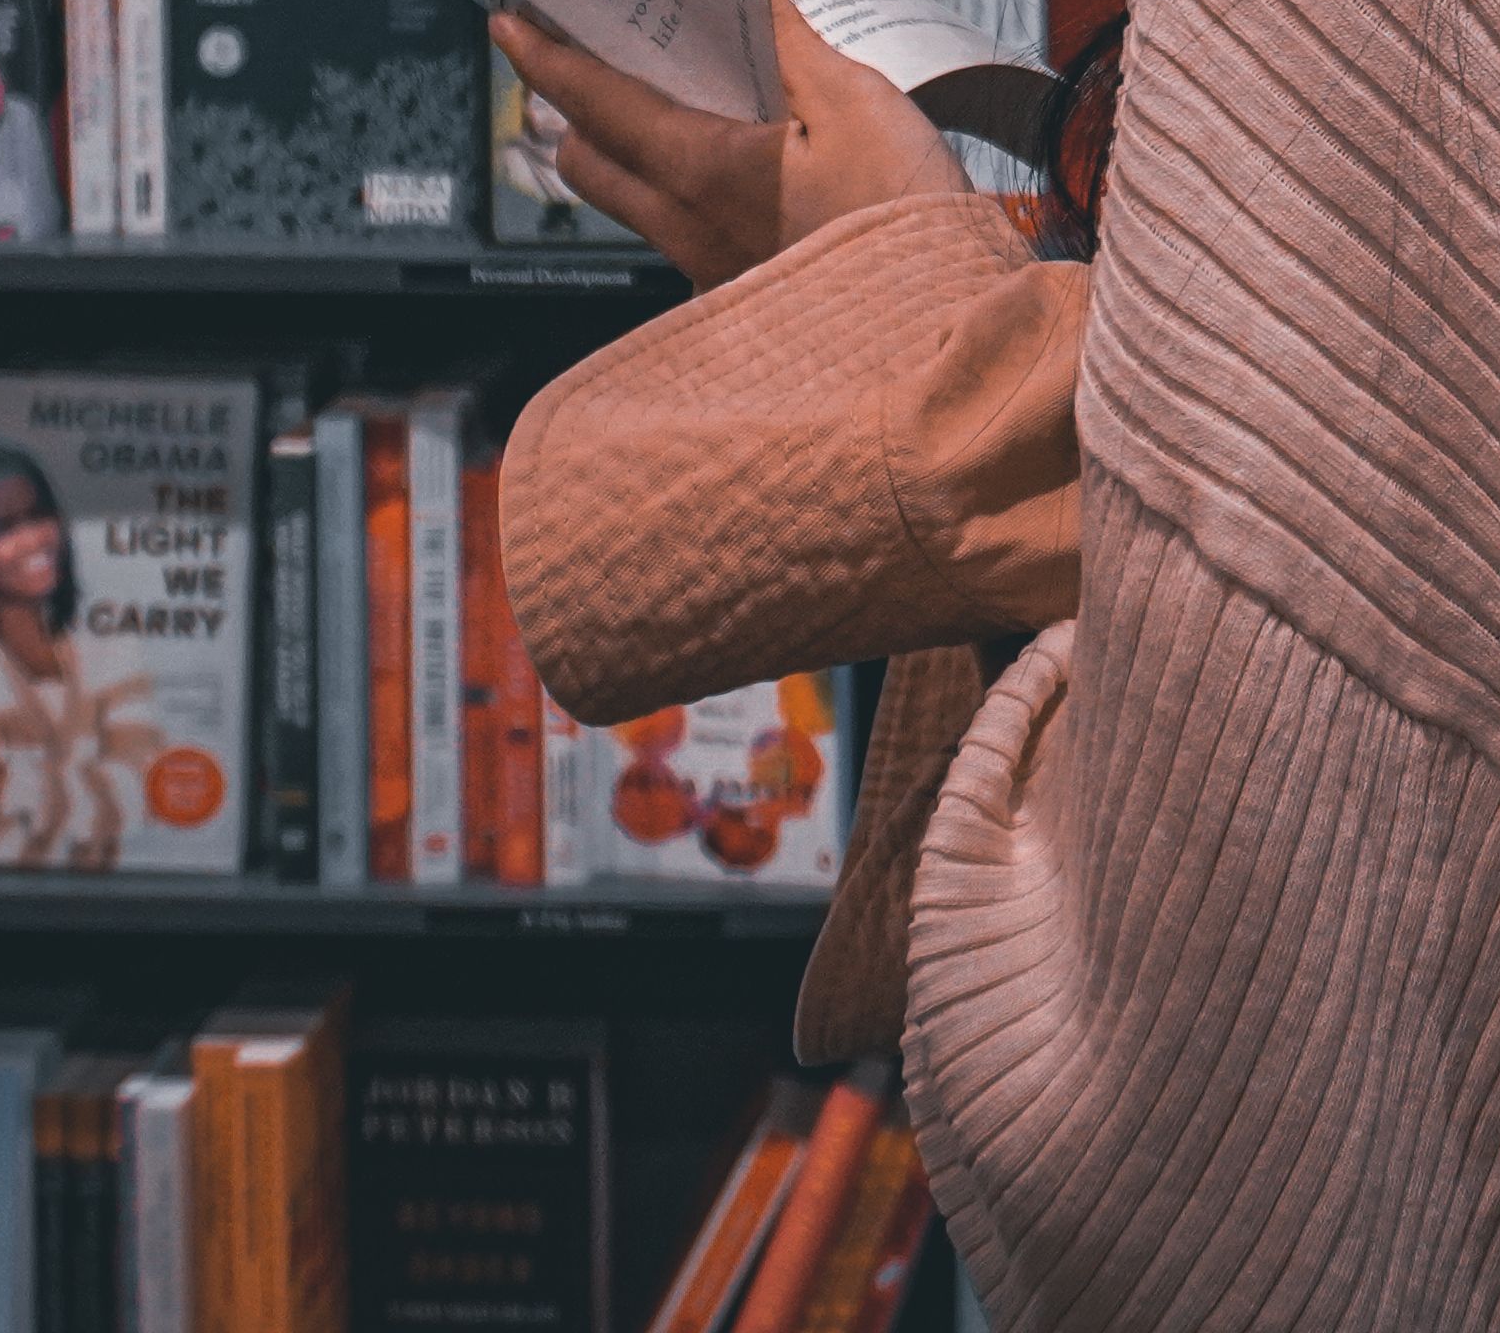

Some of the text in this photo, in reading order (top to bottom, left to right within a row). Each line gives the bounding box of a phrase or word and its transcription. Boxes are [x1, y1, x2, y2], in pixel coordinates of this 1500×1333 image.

[650, 19, 681, 51] life
[29, 398, 232, 434] MICHELLE
[79, 441, 230, 474] OBAMA
[151, 482, 226, 515] THE
[106, 520, 227, 558] LIGHT
[163, 567, 223, 596] WE
[86, 603, 223, 639] CARRY
[362, 1112, 577, 1142] PETERSON
